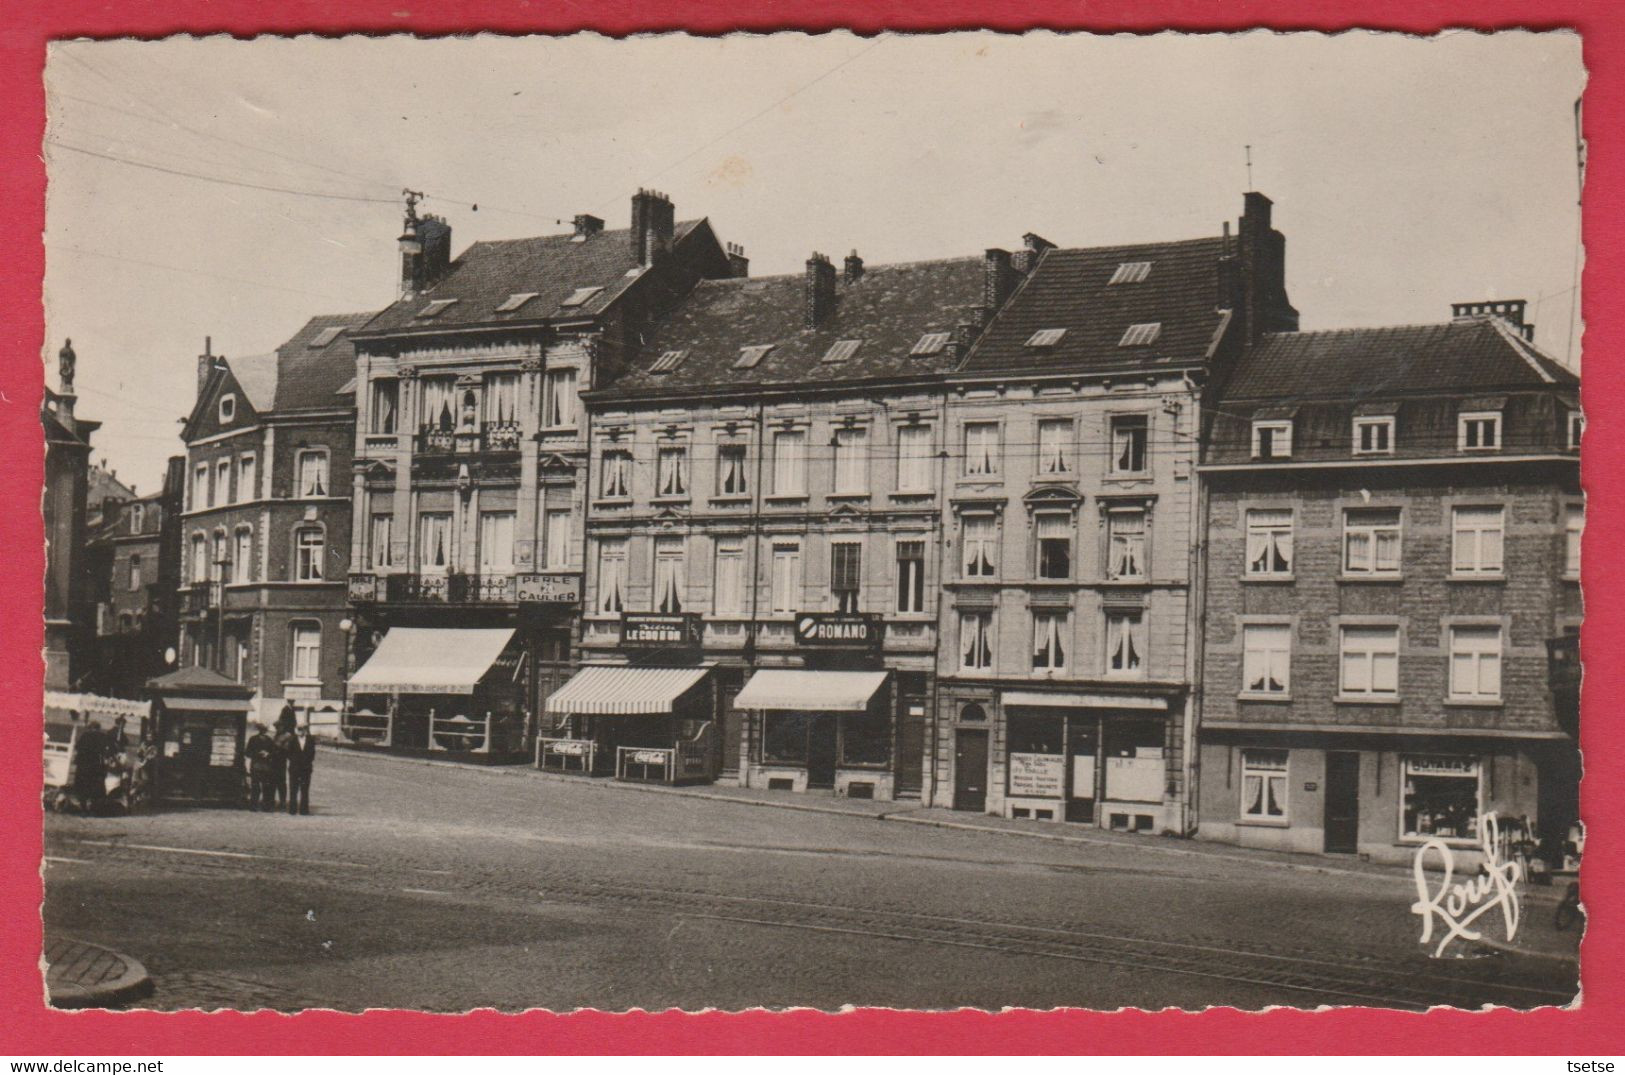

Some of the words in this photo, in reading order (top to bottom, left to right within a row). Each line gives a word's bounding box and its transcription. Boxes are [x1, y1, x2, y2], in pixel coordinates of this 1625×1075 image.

[522, 576, 571, 585] PERLE
[518, 590, 576, 601] CAULIER
[626, 629, 638, 641] LE
[818, 624, 867, 639] ROMANO
